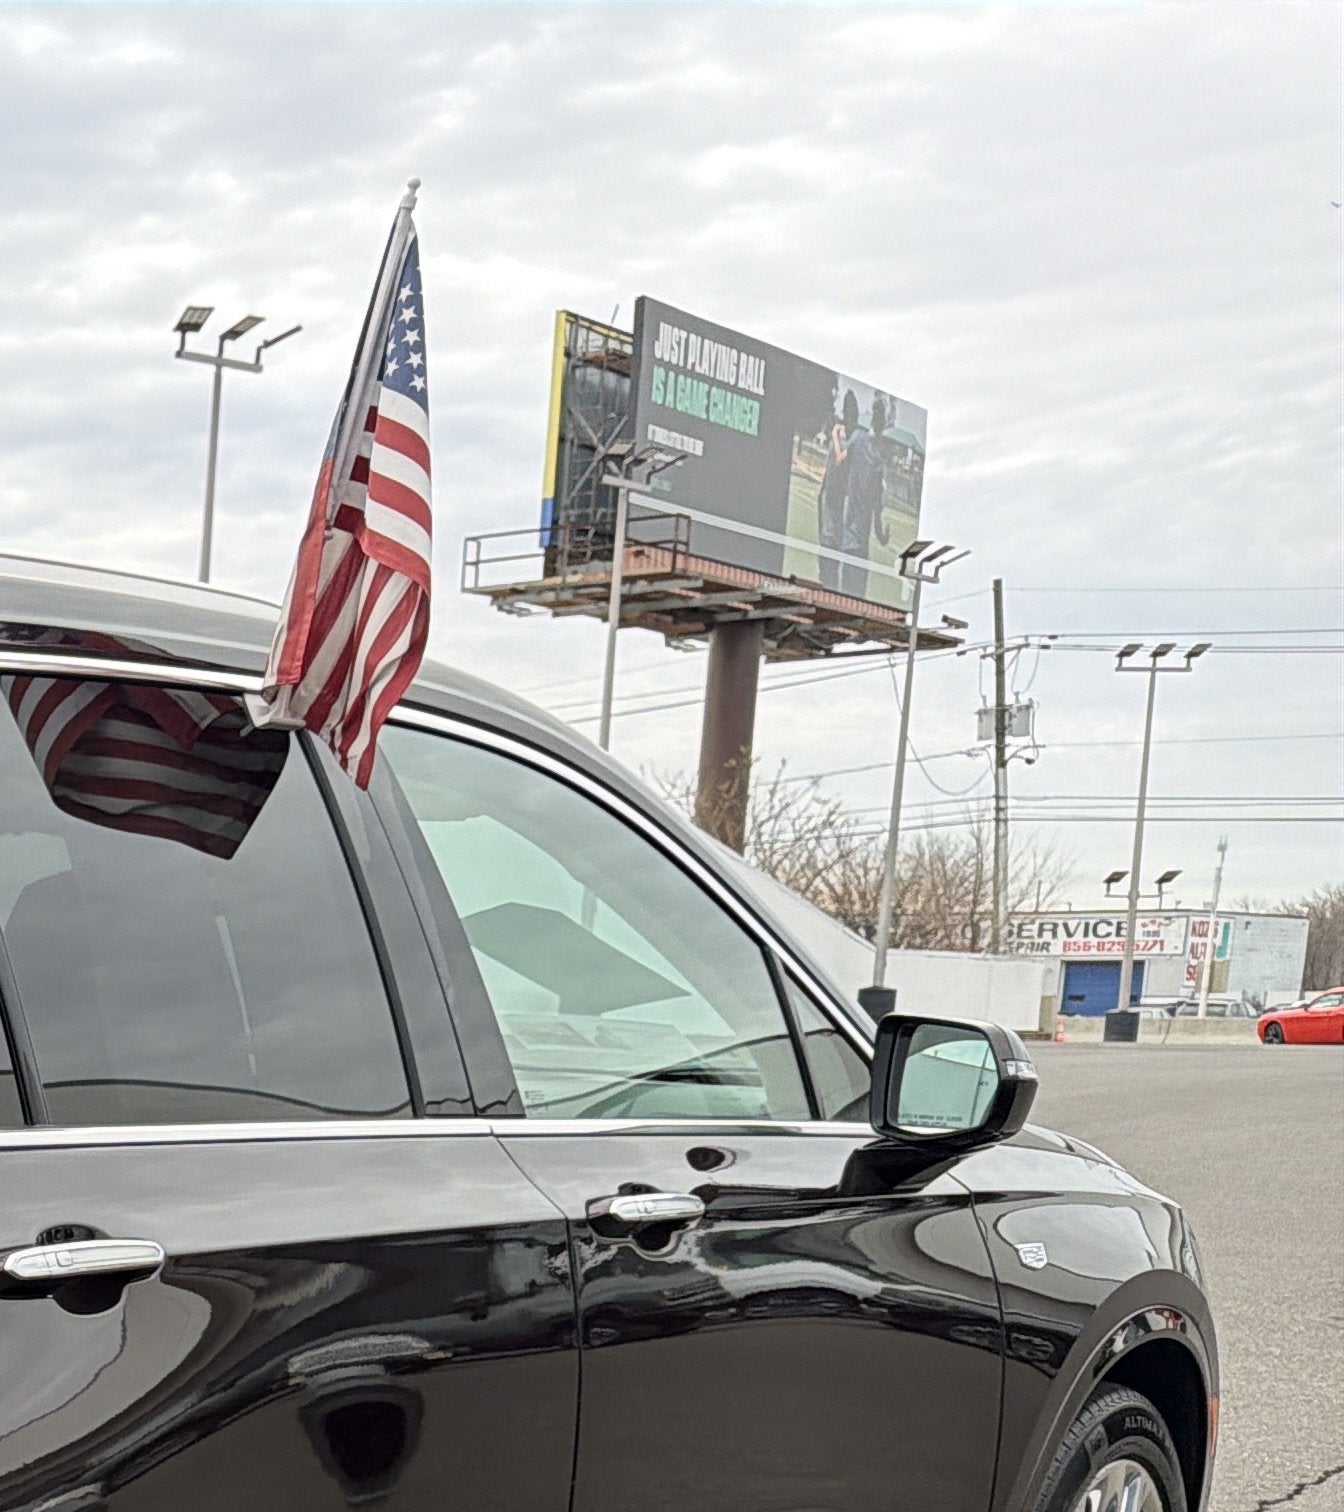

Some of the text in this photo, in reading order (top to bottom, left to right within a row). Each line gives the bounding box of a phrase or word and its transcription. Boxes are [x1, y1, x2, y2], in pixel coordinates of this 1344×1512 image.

[654, 321, 766, 396] JUST PLAYING BALL
[652, 364, 761, 437] IS A GAME CHANGER
